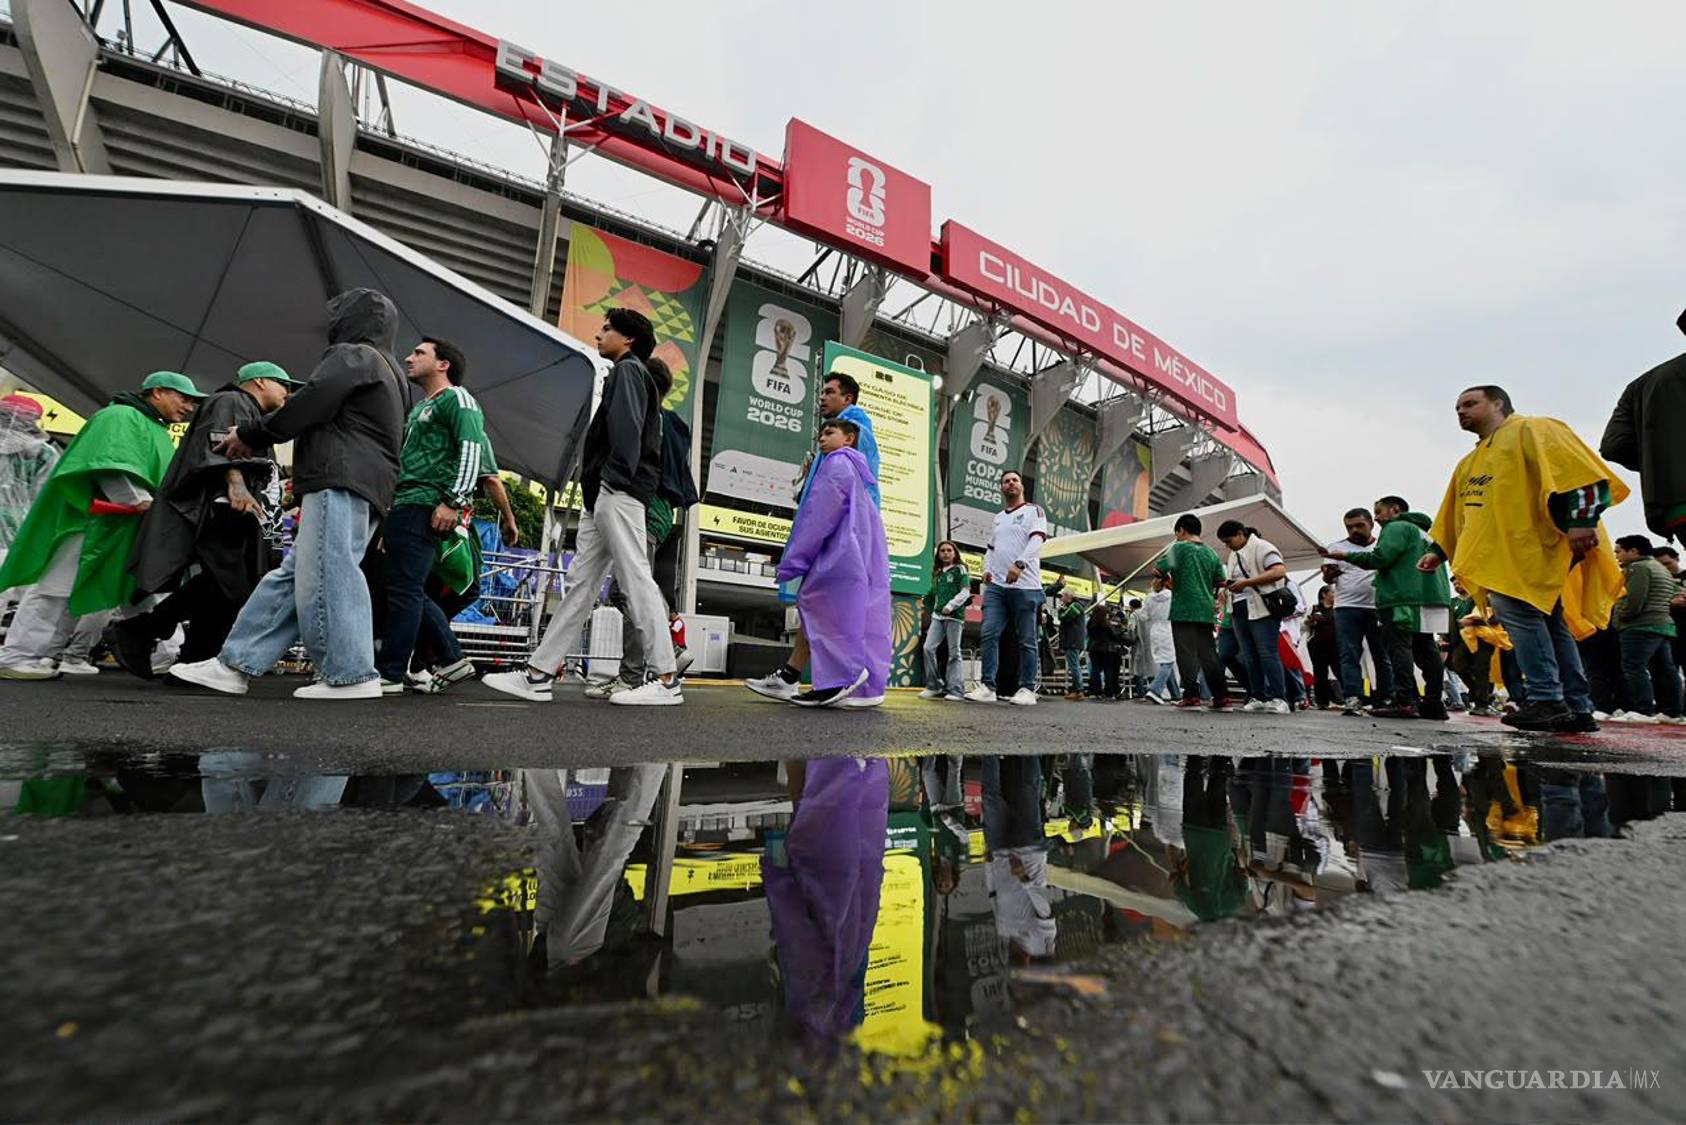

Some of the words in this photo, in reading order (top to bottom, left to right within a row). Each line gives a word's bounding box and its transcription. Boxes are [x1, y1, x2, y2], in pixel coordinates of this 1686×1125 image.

[496, 38, 757, 176] ESTADIO
[845, 223, 885, 248] 2026
[979, 251, 1101, 333] CIUDAD
[1112, 322, 1146, 361] DE
[1154, 347, 1228, 412] MÉXICO
[766, 378, 792, 395] FIFA
[749, 395, 784, 413] WORLD
[784, 404, 804, 418] CUP
[746, 407, 802, 433] 2026
[980, 444, 998, 457] FIFA
[967, 460, 1003, 481] COPA
[963, 484, 1002, 505] 2026
[732, 516, 757, 527] FAVOR
[767, 522, 791, 533] OCUPA
[738, 525, 754, 534] SUS
